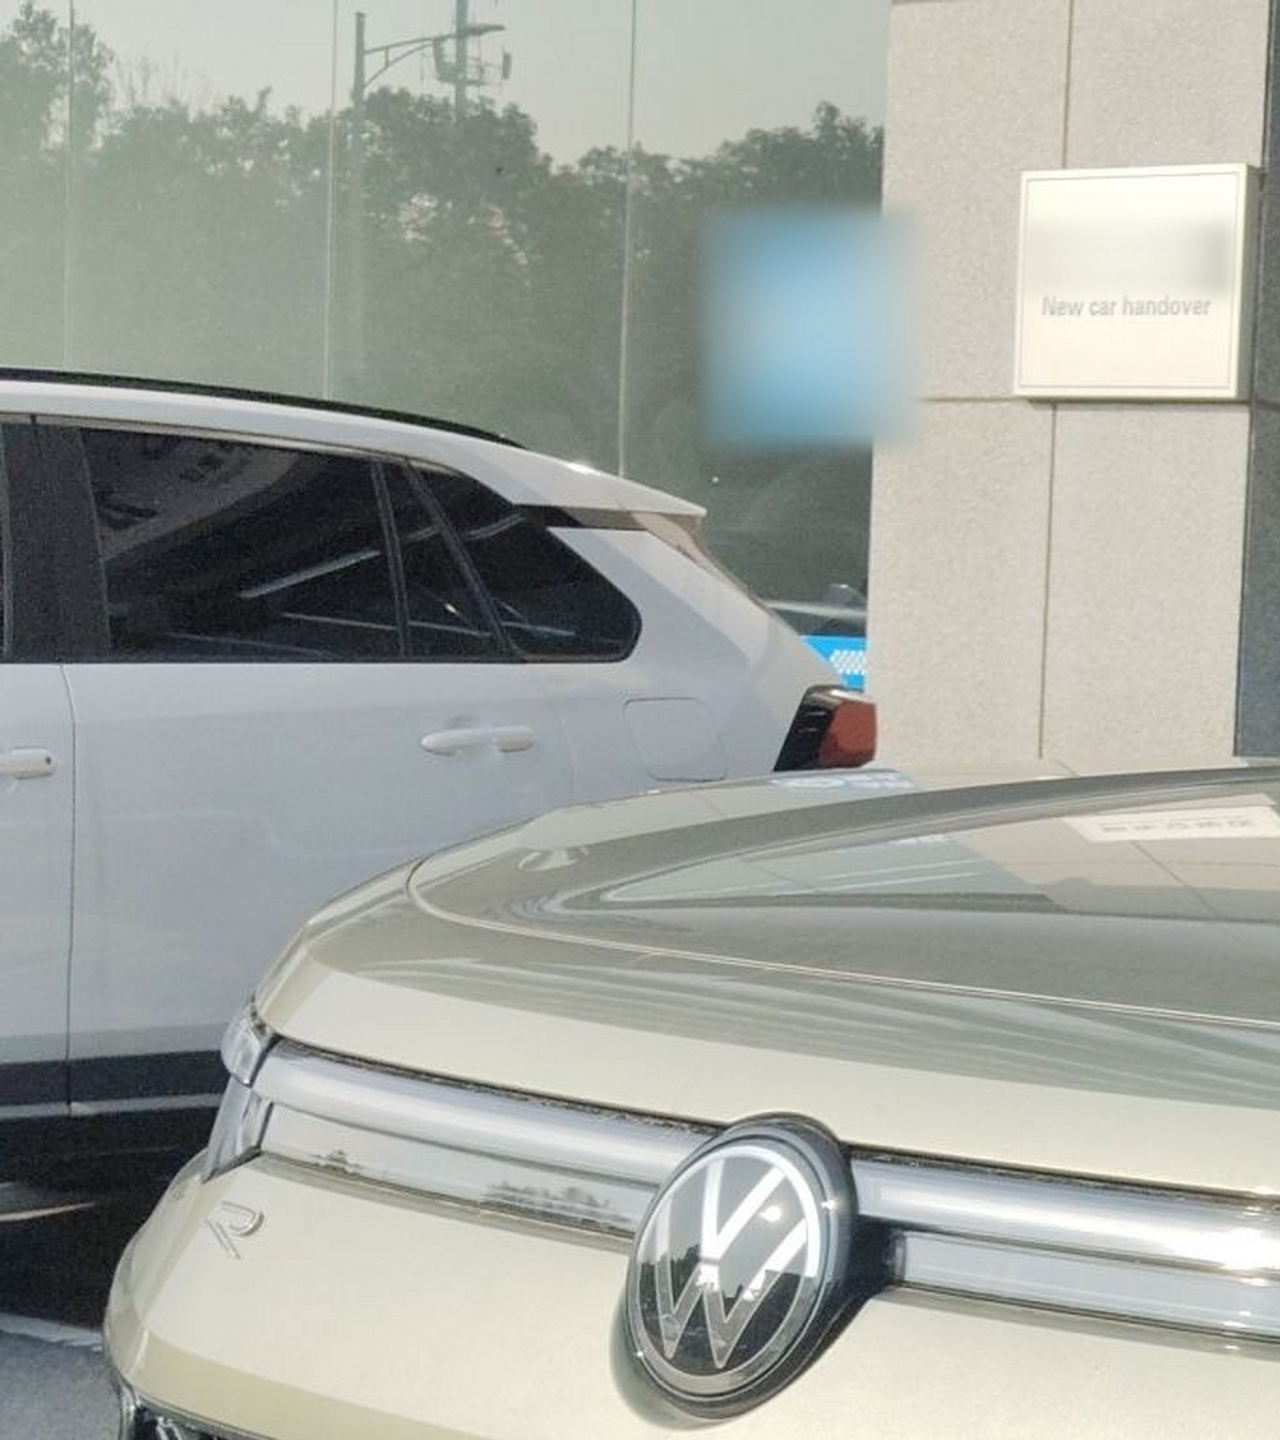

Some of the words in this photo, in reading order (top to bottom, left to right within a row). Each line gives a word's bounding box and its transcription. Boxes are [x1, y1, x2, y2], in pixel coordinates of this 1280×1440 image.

[1041, 296, 1083, 316] New
[1089, 300, 1117, 316] car
[1121, 295, 1212, 316] handover
